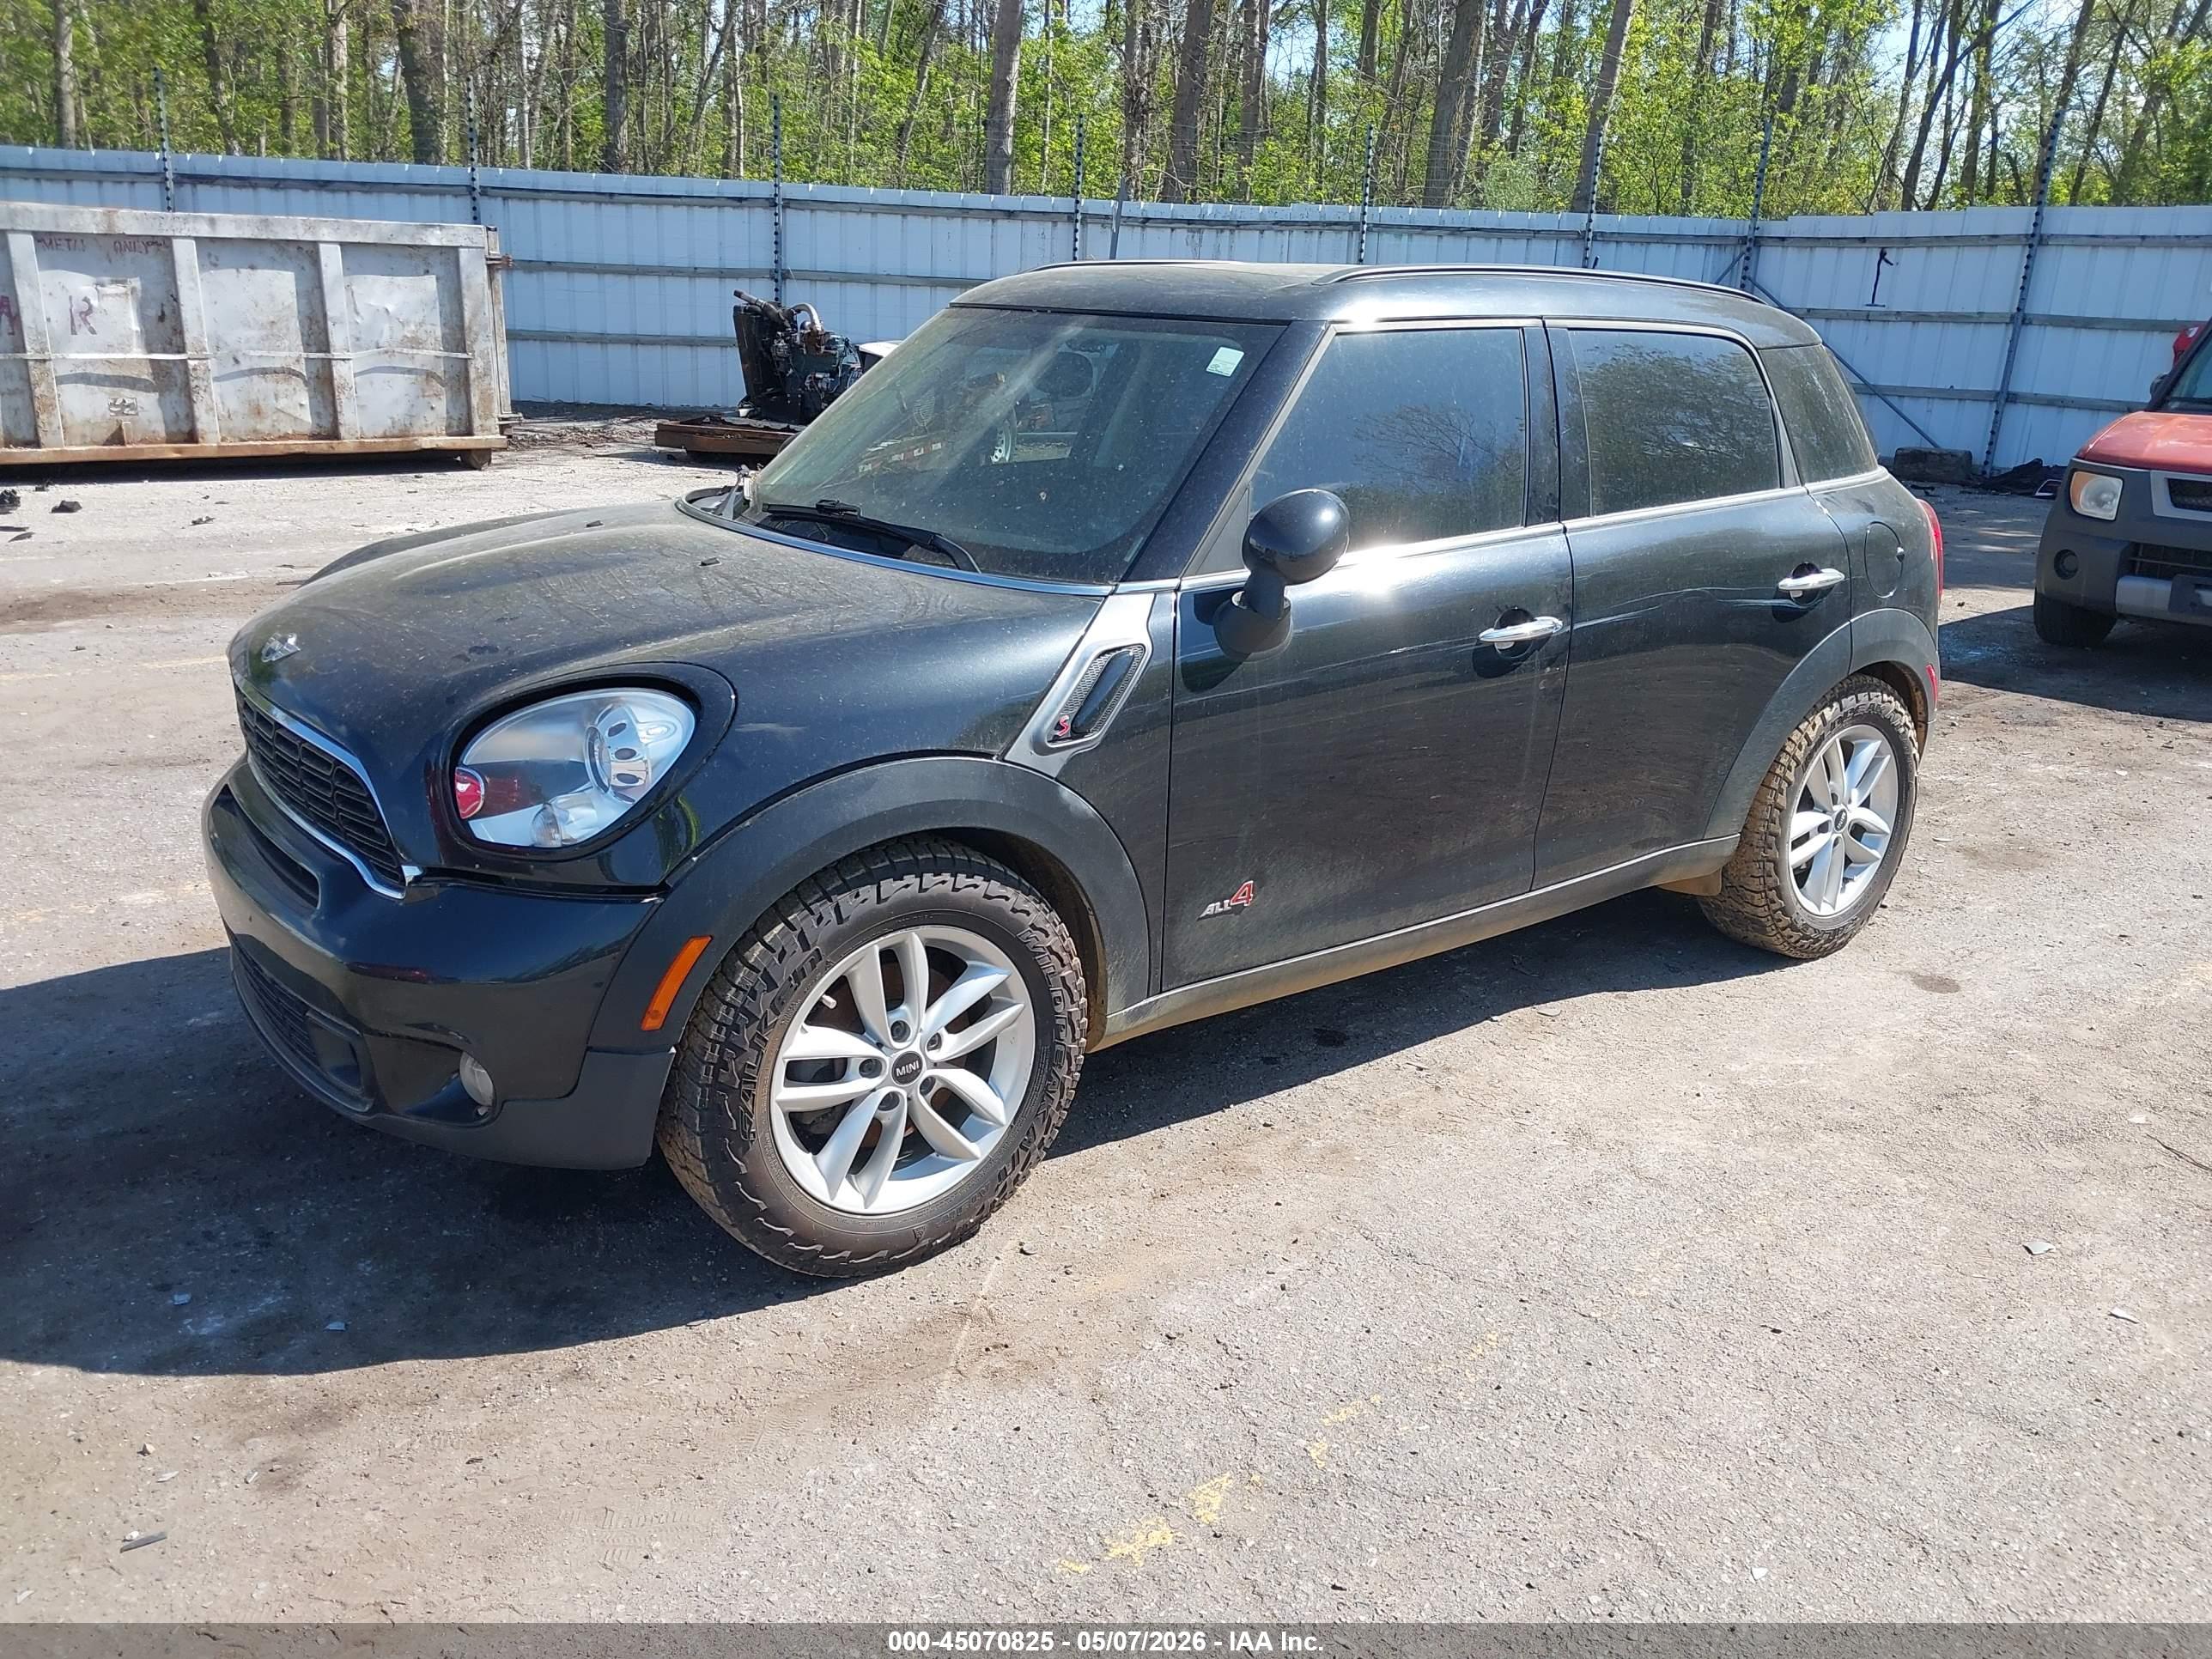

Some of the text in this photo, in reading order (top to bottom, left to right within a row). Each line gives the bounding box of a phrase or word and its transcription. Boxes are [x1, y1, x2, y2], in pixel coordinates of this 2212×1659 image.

[69, 295, 97, 335] R
[1056, 714, 1070, 737] S
[896, 1060, 920, 1077] MINI
